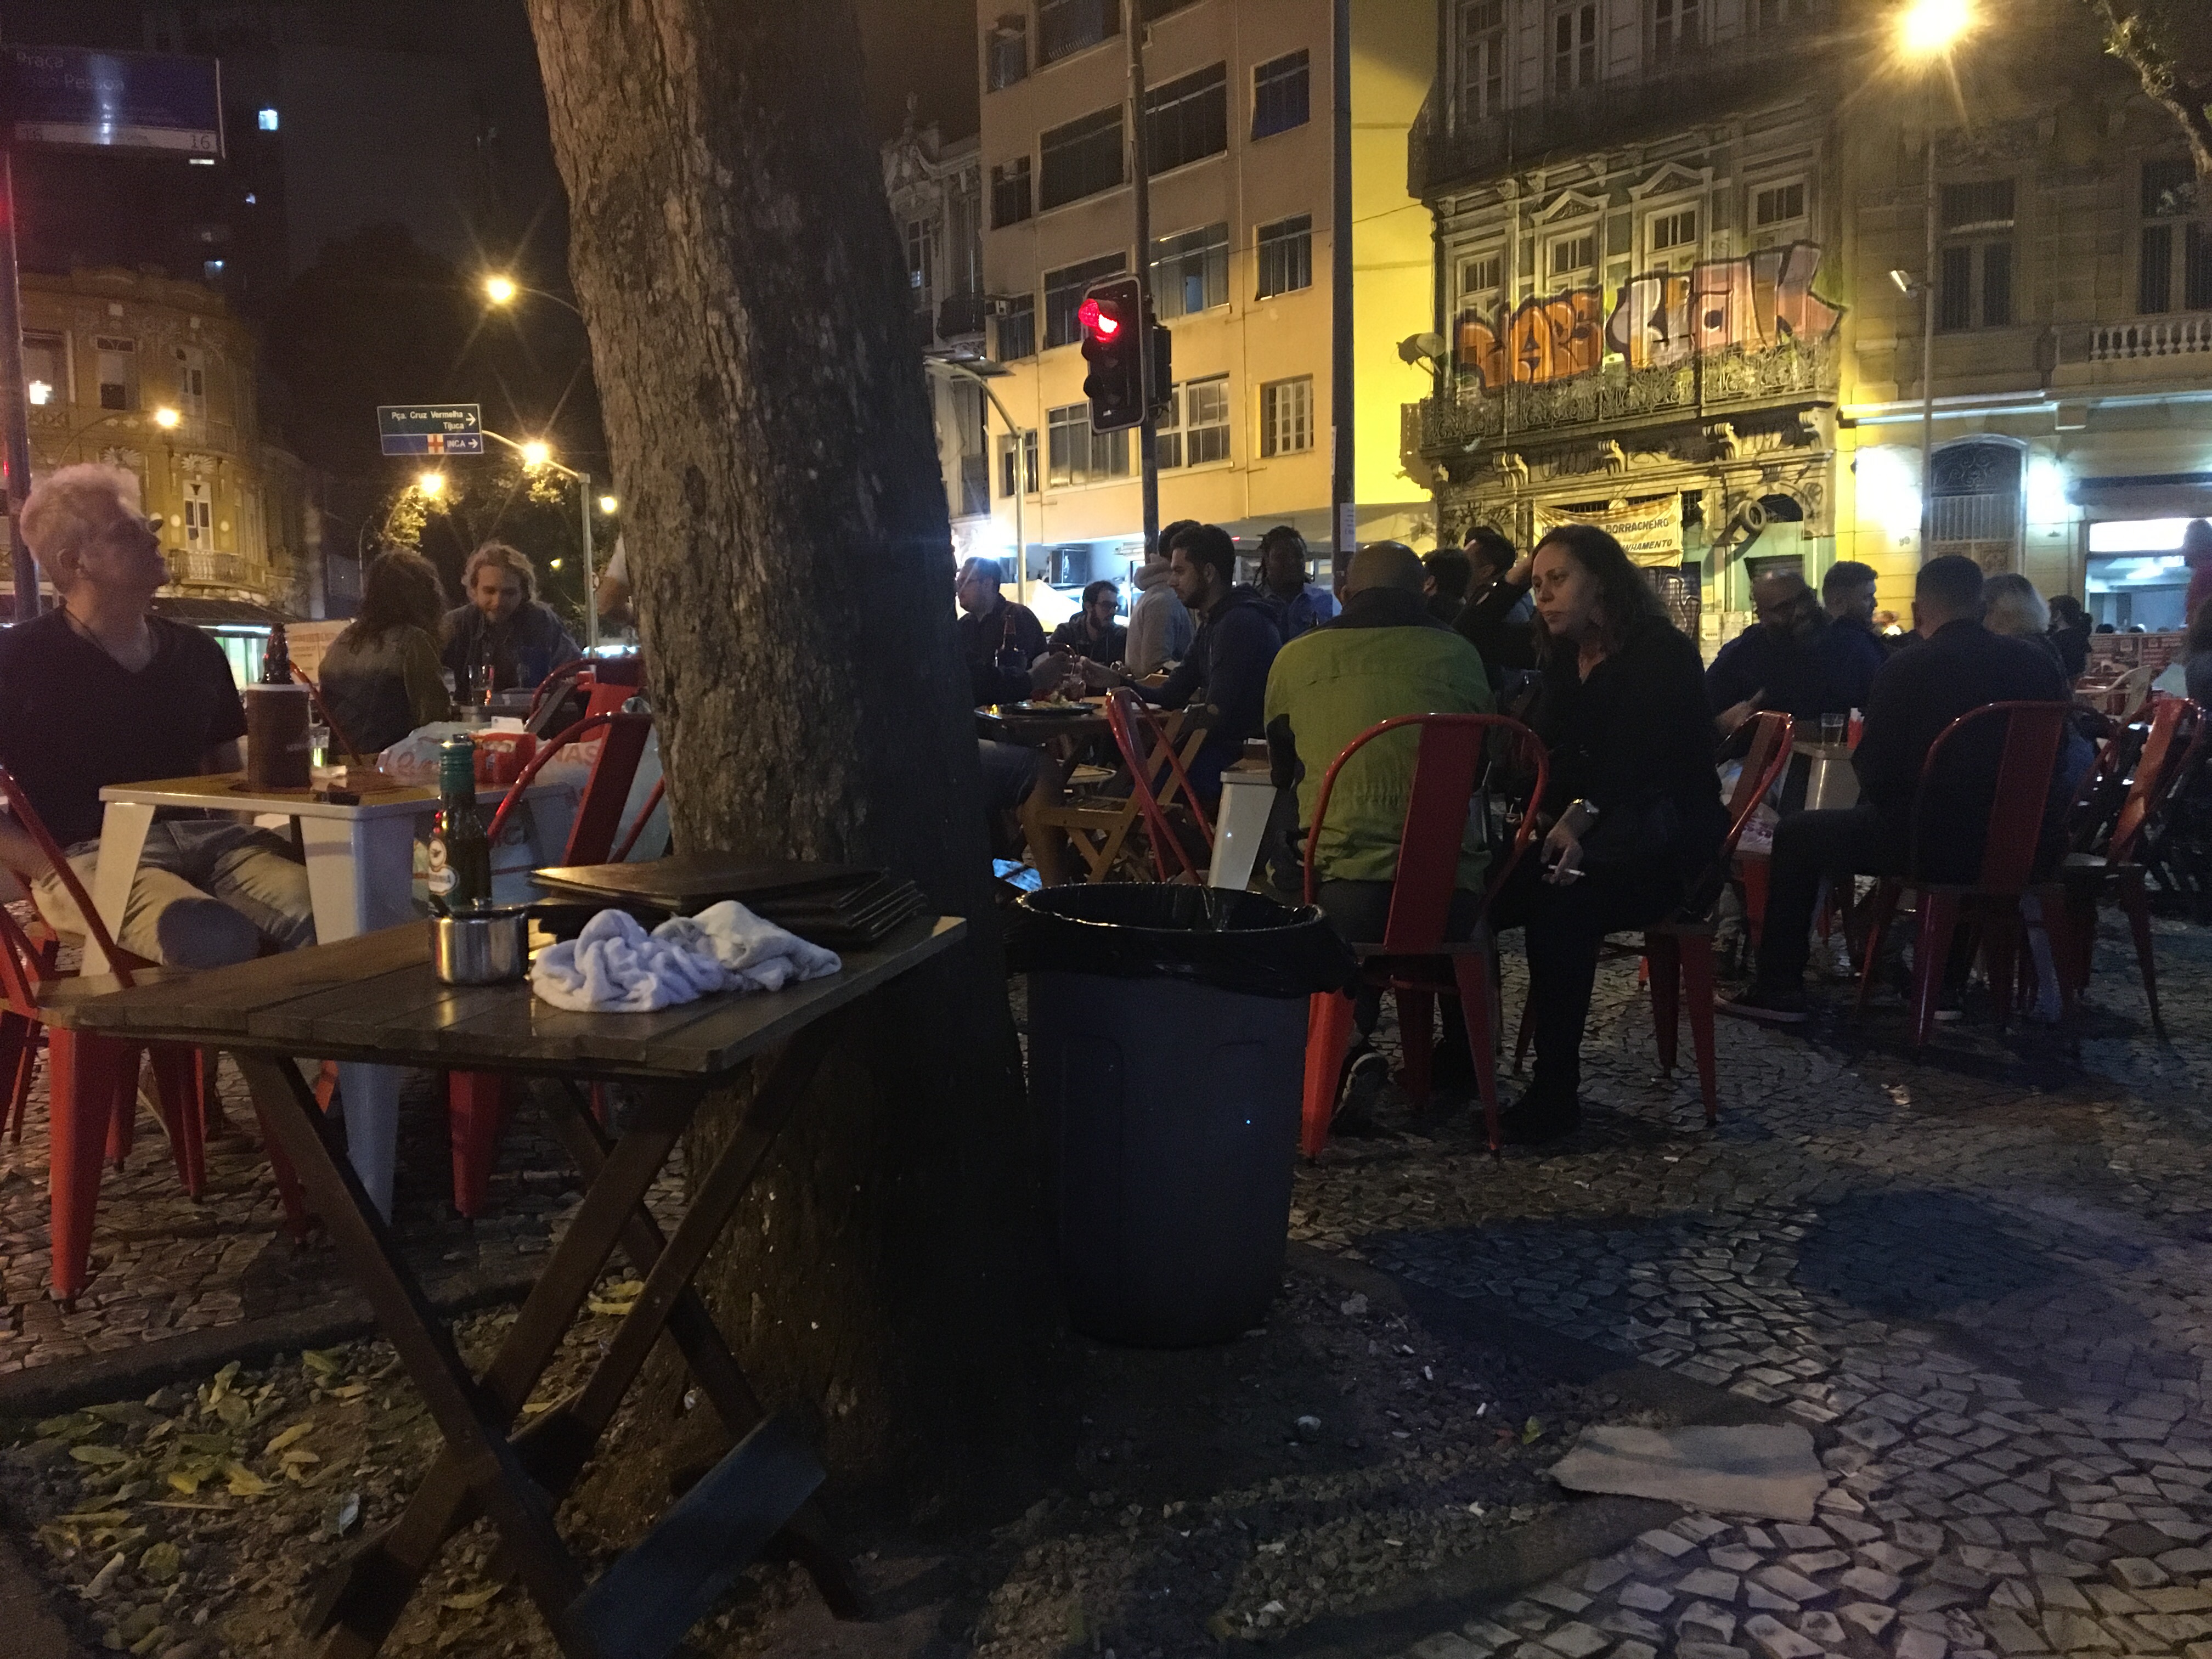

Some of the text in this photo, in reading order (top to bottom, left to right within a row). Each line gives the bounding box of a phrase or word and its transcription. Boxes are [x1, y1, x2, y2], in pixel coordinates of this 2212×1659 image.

[16, 52, 64, 70] Praça
[190, 134, 210, 149] 16
[391, 411, 407, 421] Pça.
[430, 410, 463, 419] Vermelha
[443, 422, 464, 430] Tijuca
[1605, 518, 1669, 534] BORRACHEIRO
